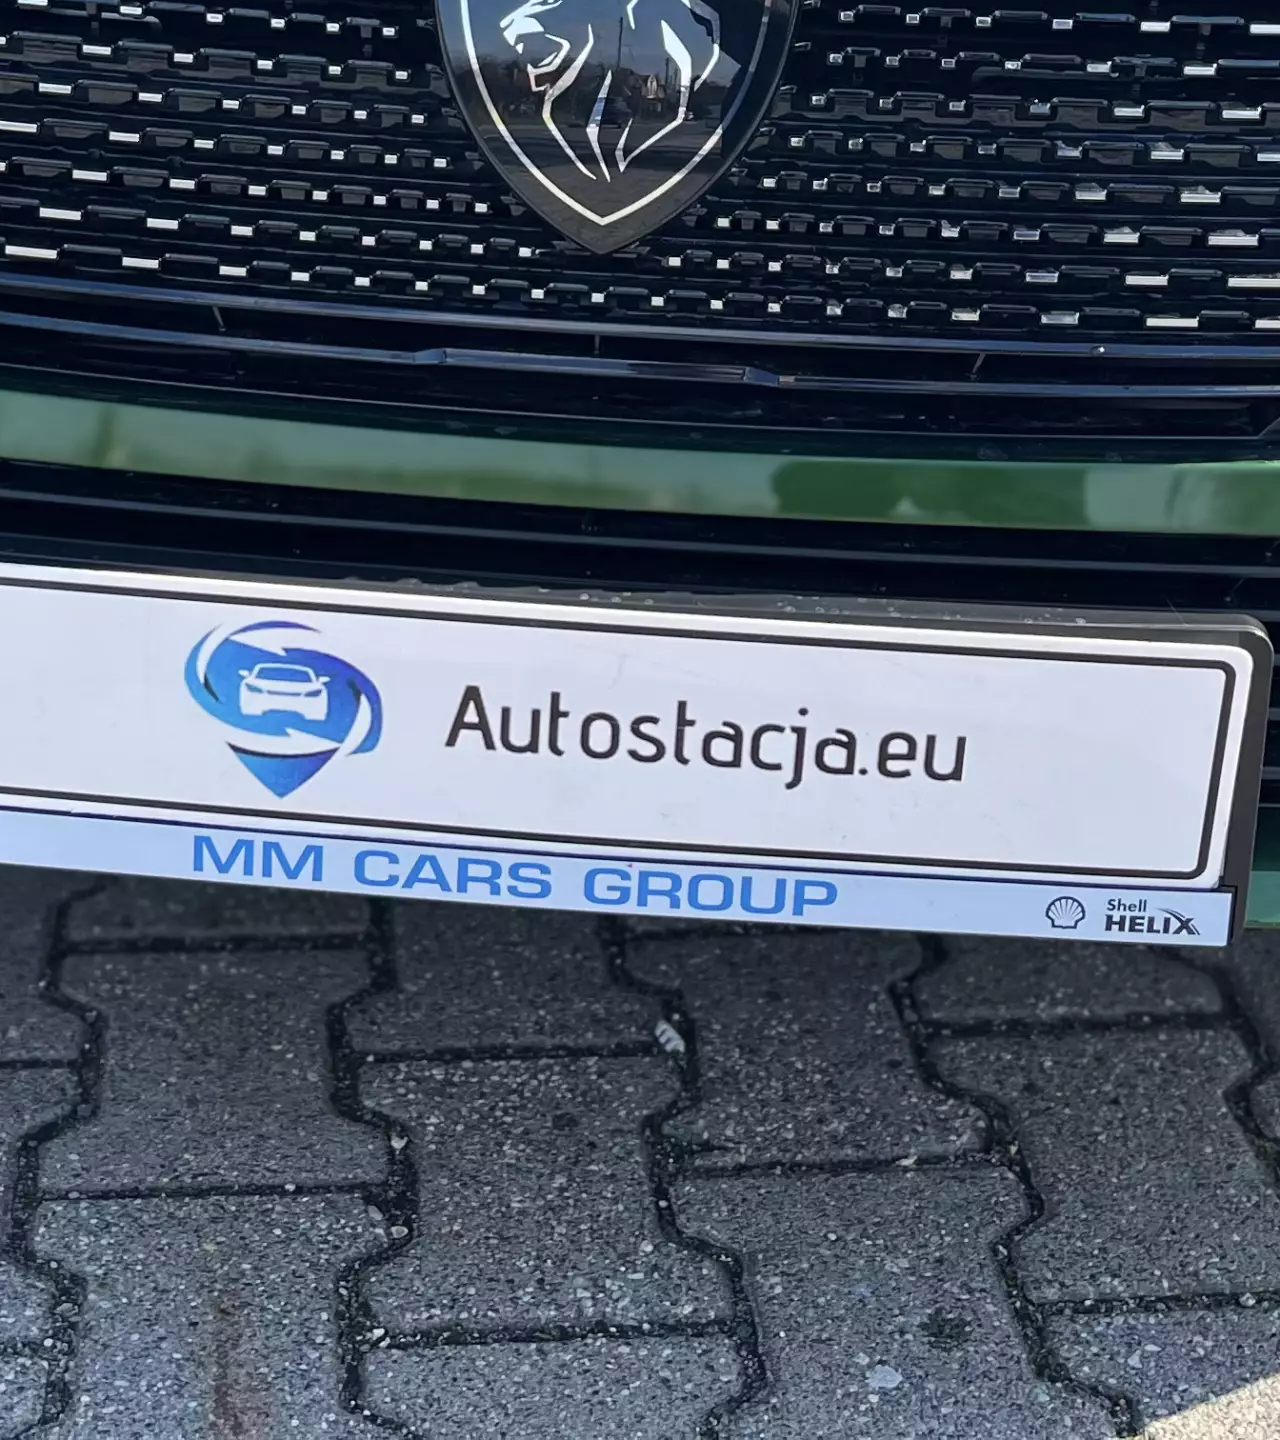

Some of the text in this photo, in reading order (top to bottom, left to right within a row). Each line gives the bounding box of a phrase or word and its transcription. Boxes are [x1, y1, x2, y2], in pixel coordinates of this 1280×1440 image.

[445, 685, 967, 790] Autostacja.eu
[192, 835, 838, 917] MM CARS GROUP
[1104, 910, 1200, 936] HELIX
[1106, 898, 1148, 913] Shell
